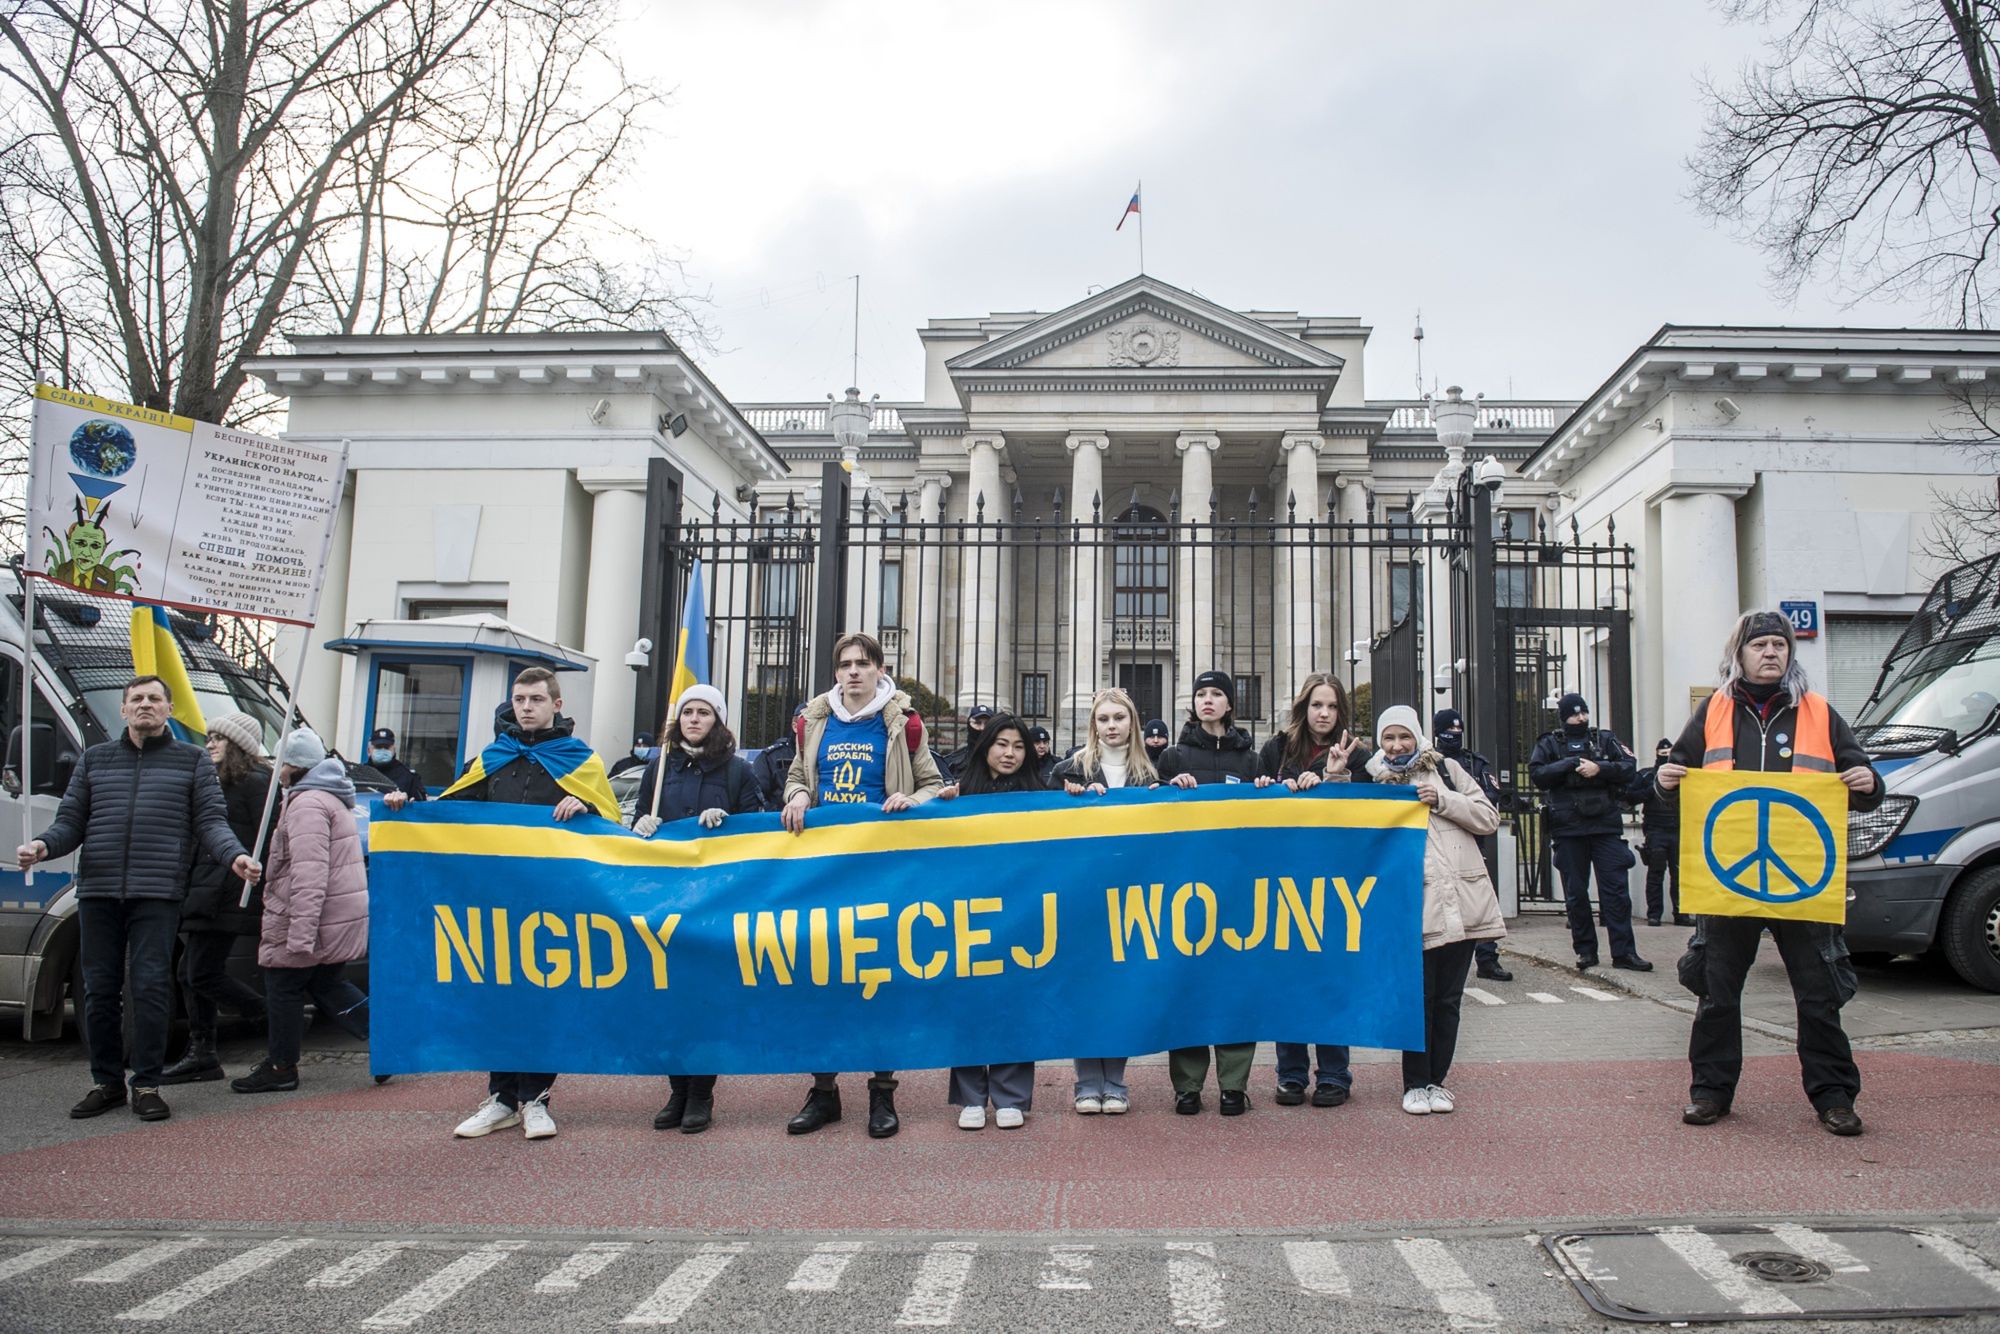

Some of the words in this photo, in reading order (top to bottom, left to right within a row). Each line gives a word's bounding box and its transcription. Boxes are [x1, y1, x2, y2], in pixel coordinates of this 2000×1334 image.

[51, 391, 95, 408] СЛАВА
[107, 403, 174, 425] УКРАЇНІ!
[214, 431, 328, 463] БЕСПРЕЦЕДЕНТНЫЙ
[204, 451, 280, 474] УКРАИНСКОГО
[245, 450, 295, 466] ГЕРОИЗМ
[211, 466, 261, 481] ПОСЛЕДНИЙ
[269, 478, 314, 492] ПЛАЦДАРМ
[203, 484, 266, 501] УНИЧТОЖЕНИЮ
[212, 476, 234, 485] ПУТИ
[238, 481, 291, 497] ПУТИНСКОГО
[293, 493, 330, 504] РЕЖИМА
[206, 494, 226, 503] ЕСЛИ
[223, 507, 260, 519] КАЖДЫЙ
[220, 517, 258, 529] КАЖДЫЙ
[202, 532, 232, 543] ЖИЗНЬ
[199, 542, 246, 558] СПЕШИ
[182, 551, 200, 559] КАК
[251, 563, 312, 578] УКРАИНЕ!
[184, 563, 222, 575] КАЖДАЯ
[229, 573, 282, 585] ПОТЕРЯННАЯ
[285, 581, 310, 589] МНОЮ
[206, 588, 276, 604] ОСТАНОВИТЬ
[239, 584, 271, 593] МИНУТА
[275, 589, 306, 599] МОЖЕТ
[191, 596, 228, 607] ВРЕМЯ
[234, 602, 255, 611] ДЛЯ
[1790, 609, 1812, 629] 49
[828, 743, 873, 752] РУССКИЙ
[824, 791, 866, 803] НАХУЙ
[433, 903, 681, 989] NIGDY
[733, 892, 1057, 1000] WIĘCEJ
[1106, 876, 1377, 962] WOJNY
